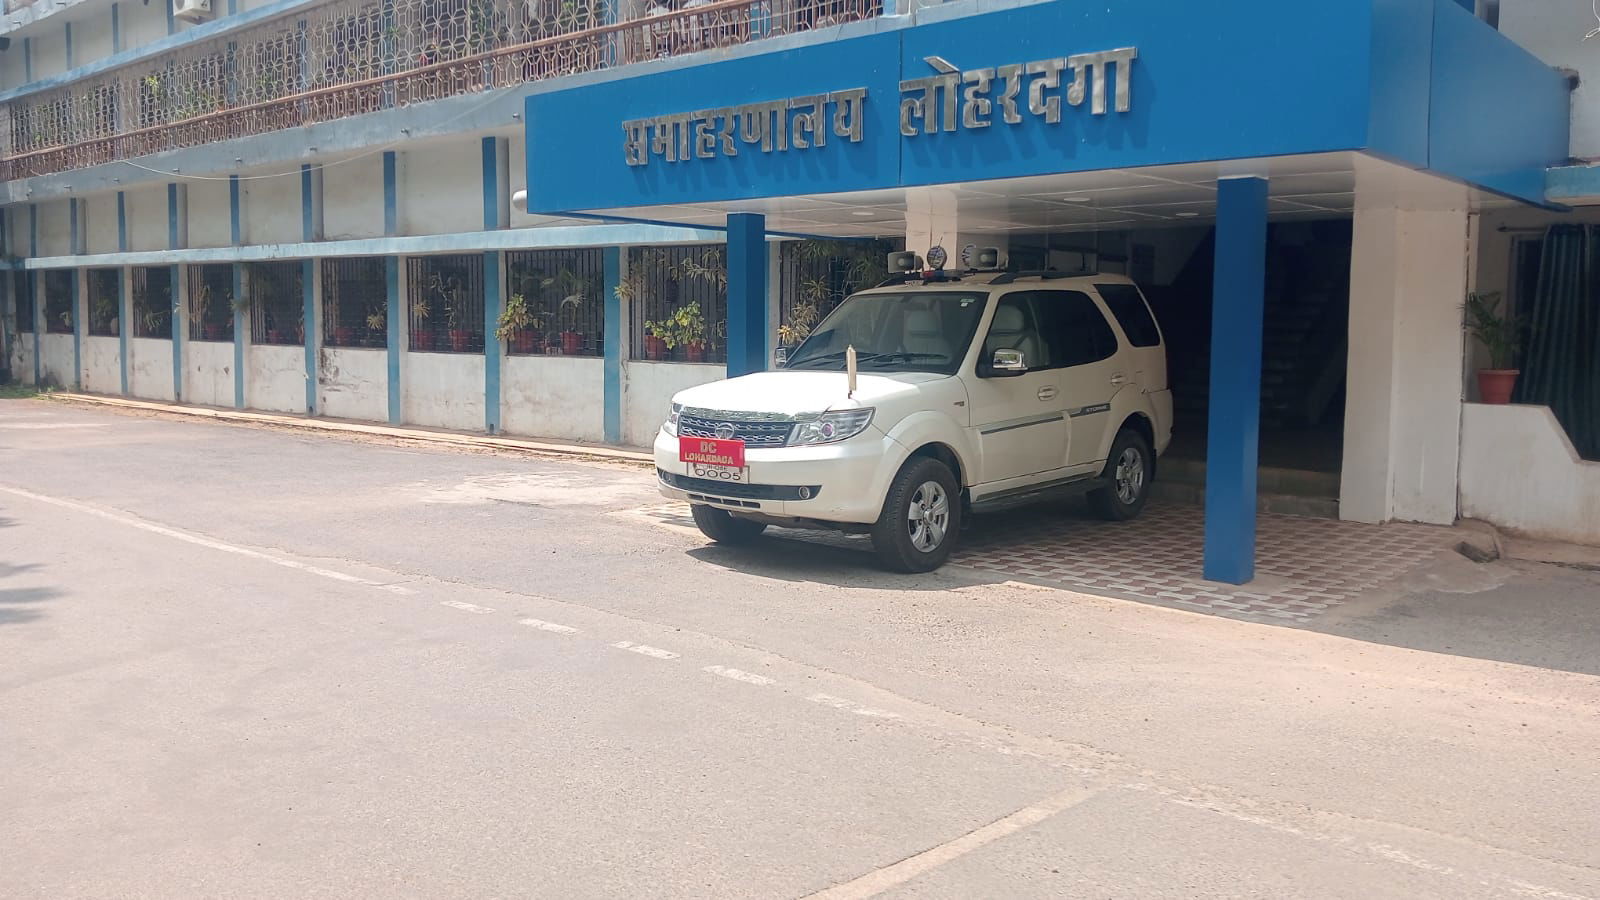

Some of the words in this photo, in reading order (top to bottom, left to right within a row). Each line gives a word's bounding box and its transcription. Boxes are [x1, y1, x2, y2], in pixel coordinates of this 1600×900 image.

[622, 87, 868, 166] समाहरणालय
[899, 47, 1138, 136] लोहरदगा
[700, 441, 717, 453] DC
[695, 468, 741, 480] 0005
